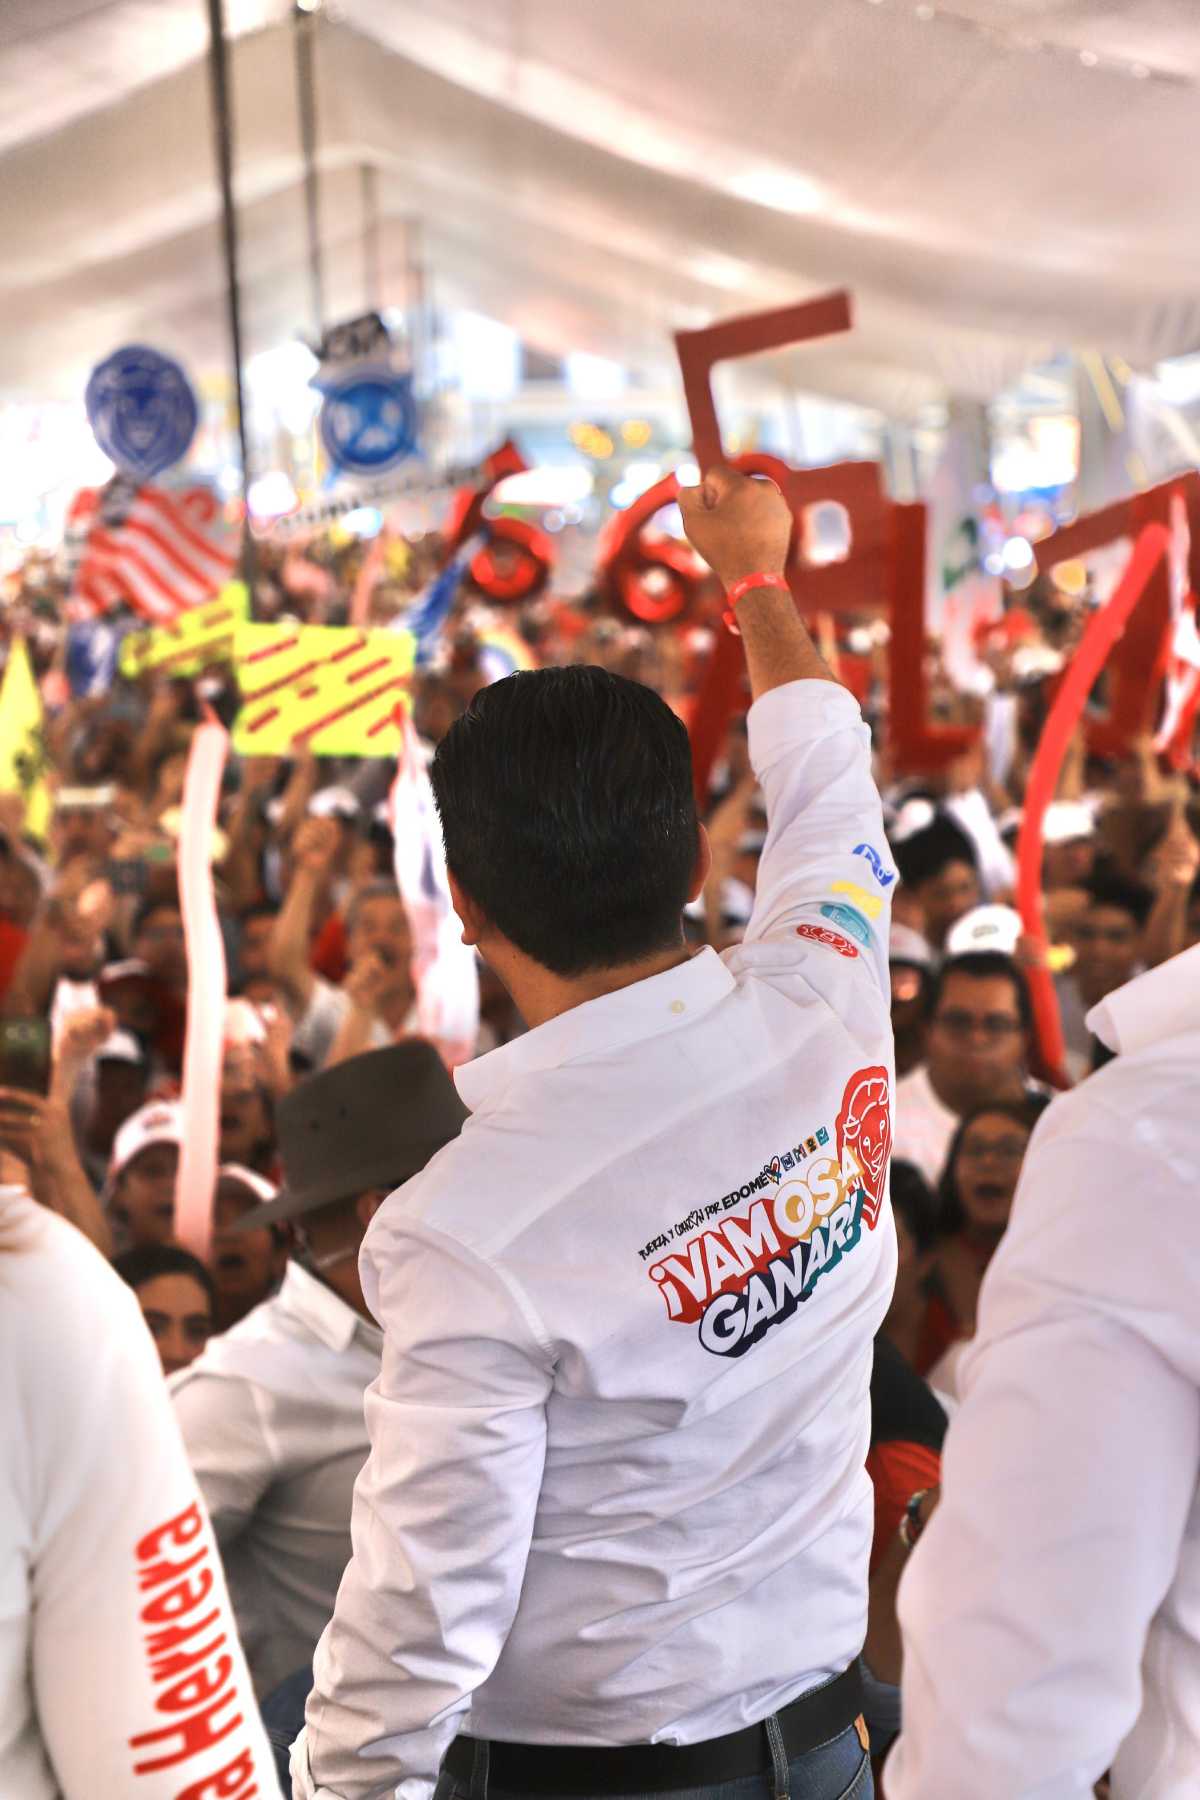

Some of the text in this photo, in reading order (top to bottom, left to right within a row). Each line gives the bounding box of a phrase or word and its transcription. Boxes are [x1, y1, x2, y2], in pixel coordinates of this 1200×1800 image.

[667, 1229, 675, 1239] Y
[704, 1201, 722, 1220] POR
[699, 1189, 865, 1358] GANAR!
[129, 1500, 244, 1776] Herrera
